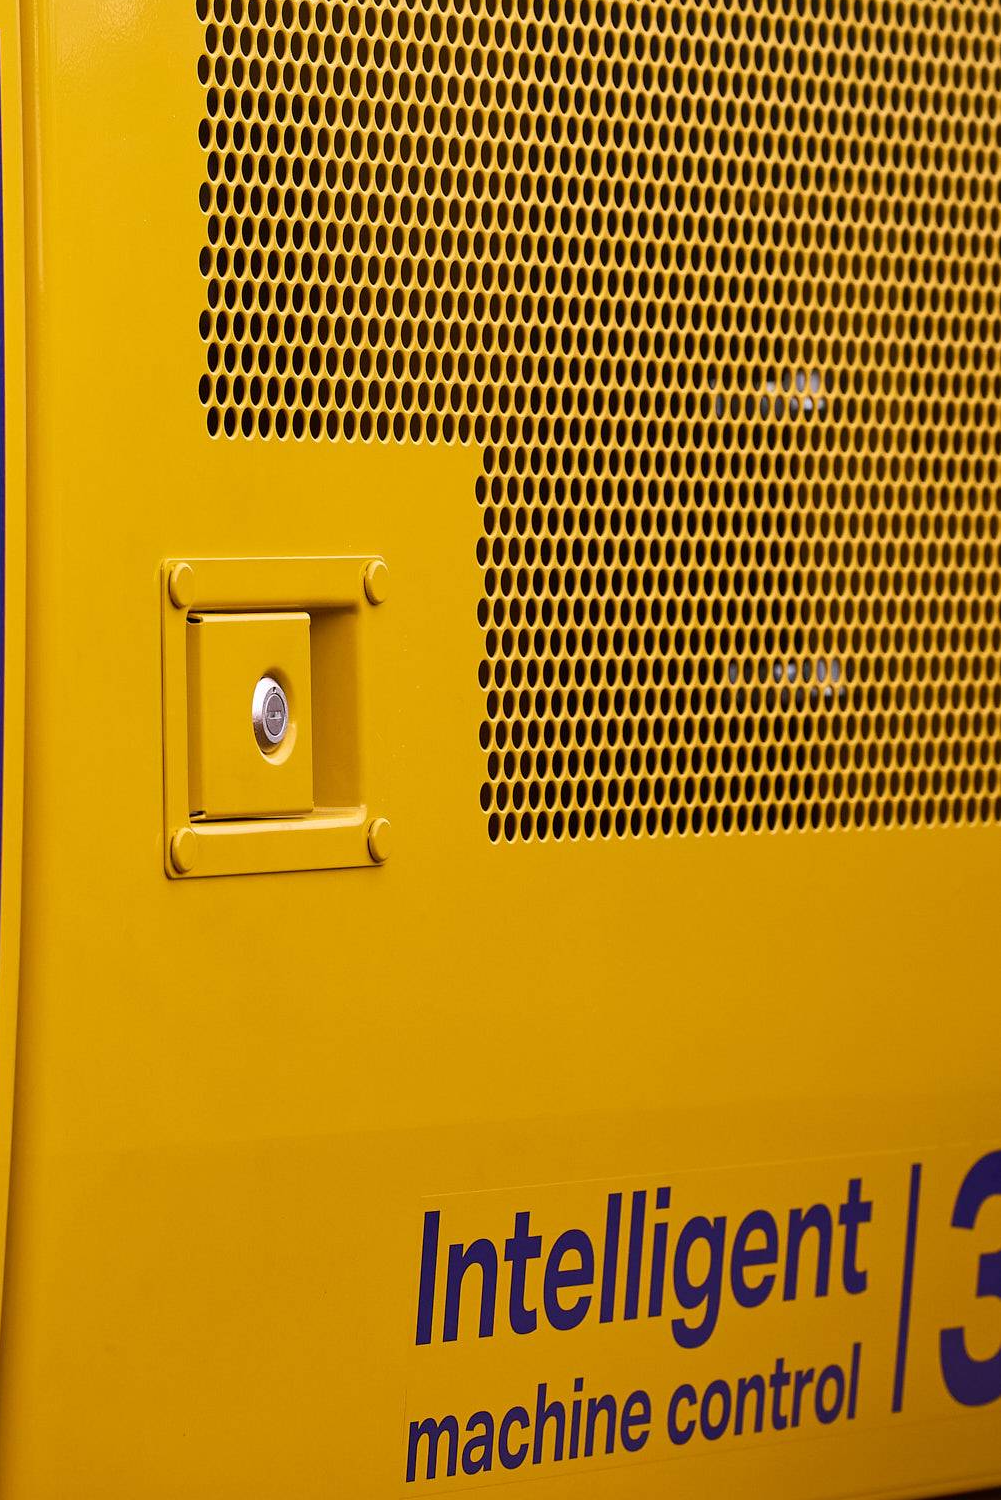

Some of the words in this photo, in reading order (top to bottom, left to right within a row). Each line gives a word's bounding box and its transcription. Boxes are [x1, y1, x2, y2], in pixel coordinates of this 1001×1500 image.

[415, 1178, 873, 1349] Intelligent
[405, 1377, 652, 1483] machine
[667, 1342, 861, 1446] control
